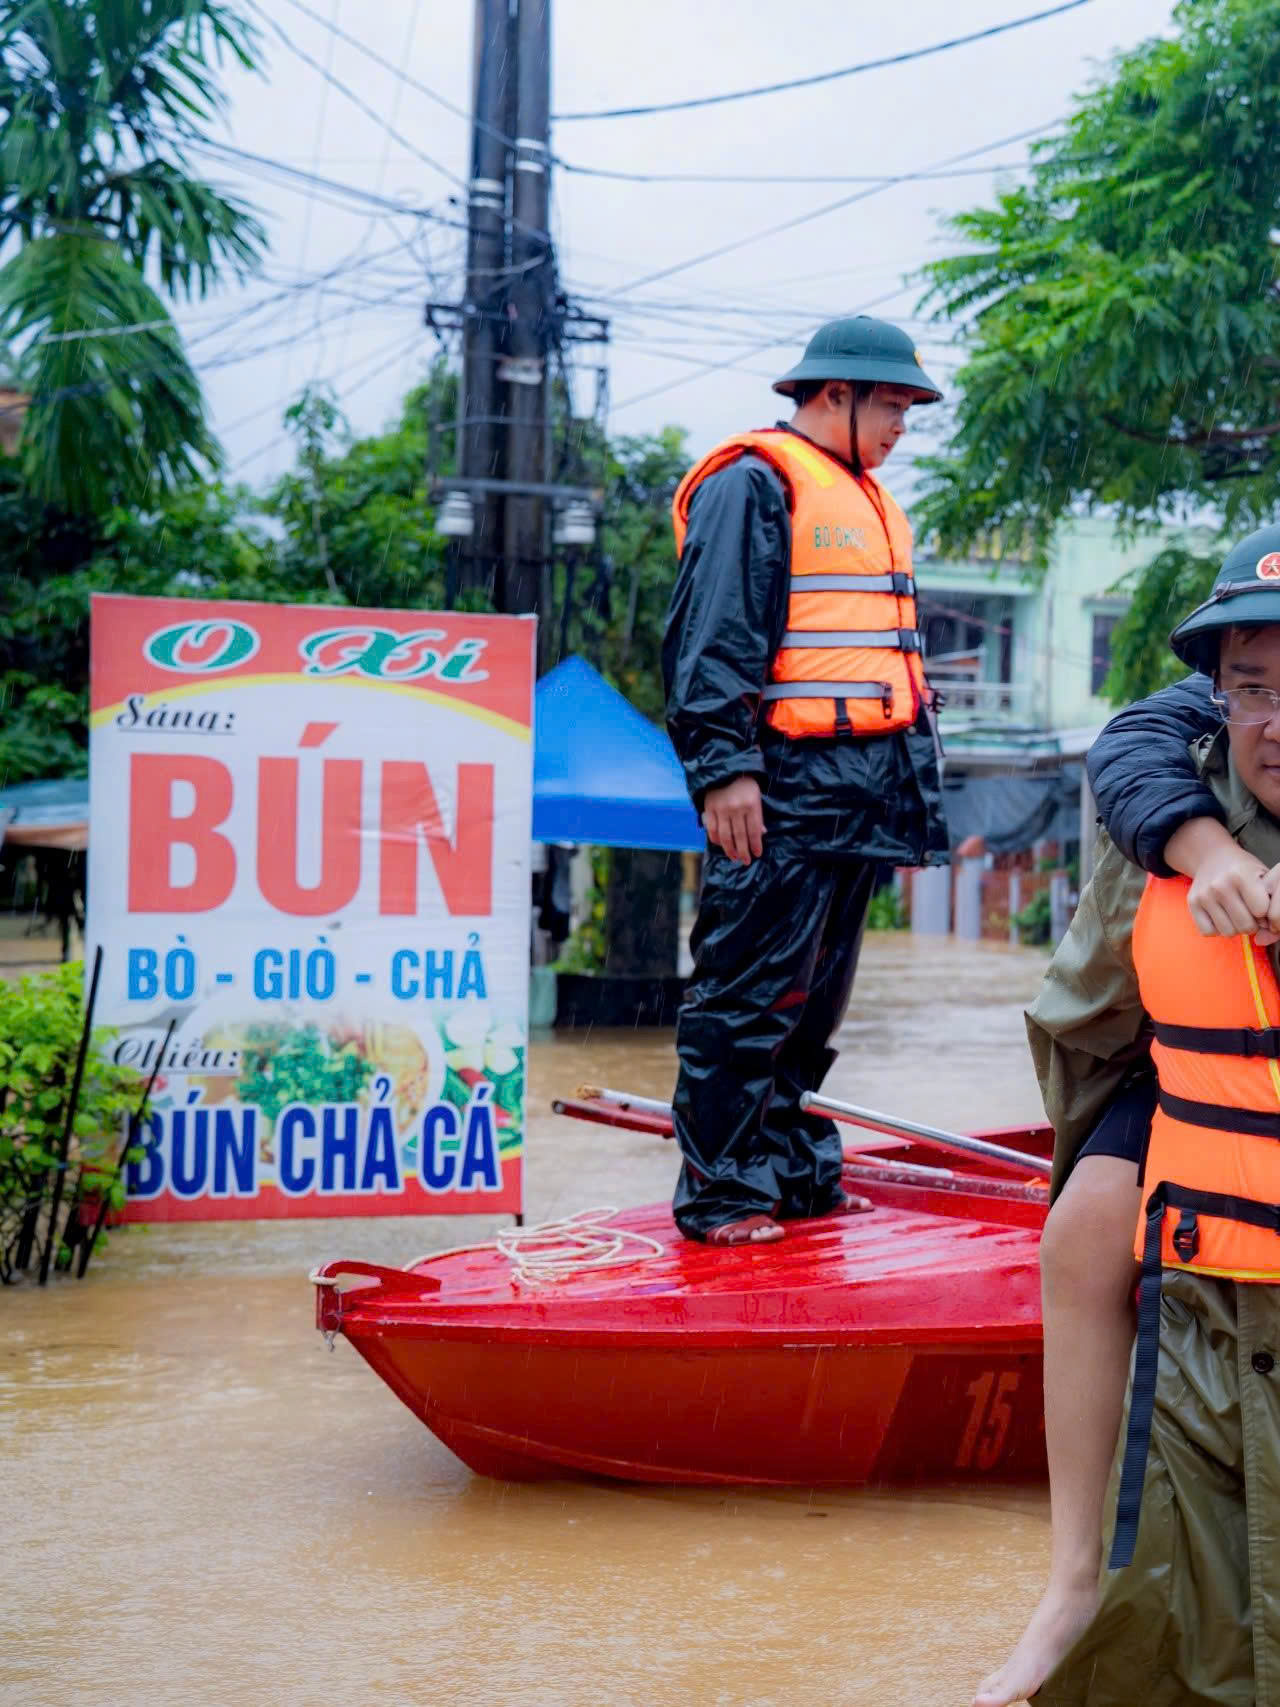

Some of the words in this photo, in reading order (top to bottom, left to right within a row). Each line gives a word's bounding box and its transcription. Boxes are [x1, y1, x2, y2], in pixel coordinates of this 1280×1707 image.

[144, 619, 261, 674] O
[127, 721, 496, 918] BÚN
[128, 934, 196, 1001] BÒ
[254, 936, 336, 1001] GIÒ
[391, 930, 488, 1000] CHẢ
[126, 1088, 257, 1195] BÚN
[279, 1075, 400, 1193] CHẢ
[421, 1085, 498, 1190] CÁ
[955, 1370, 1021, 1471] 15
